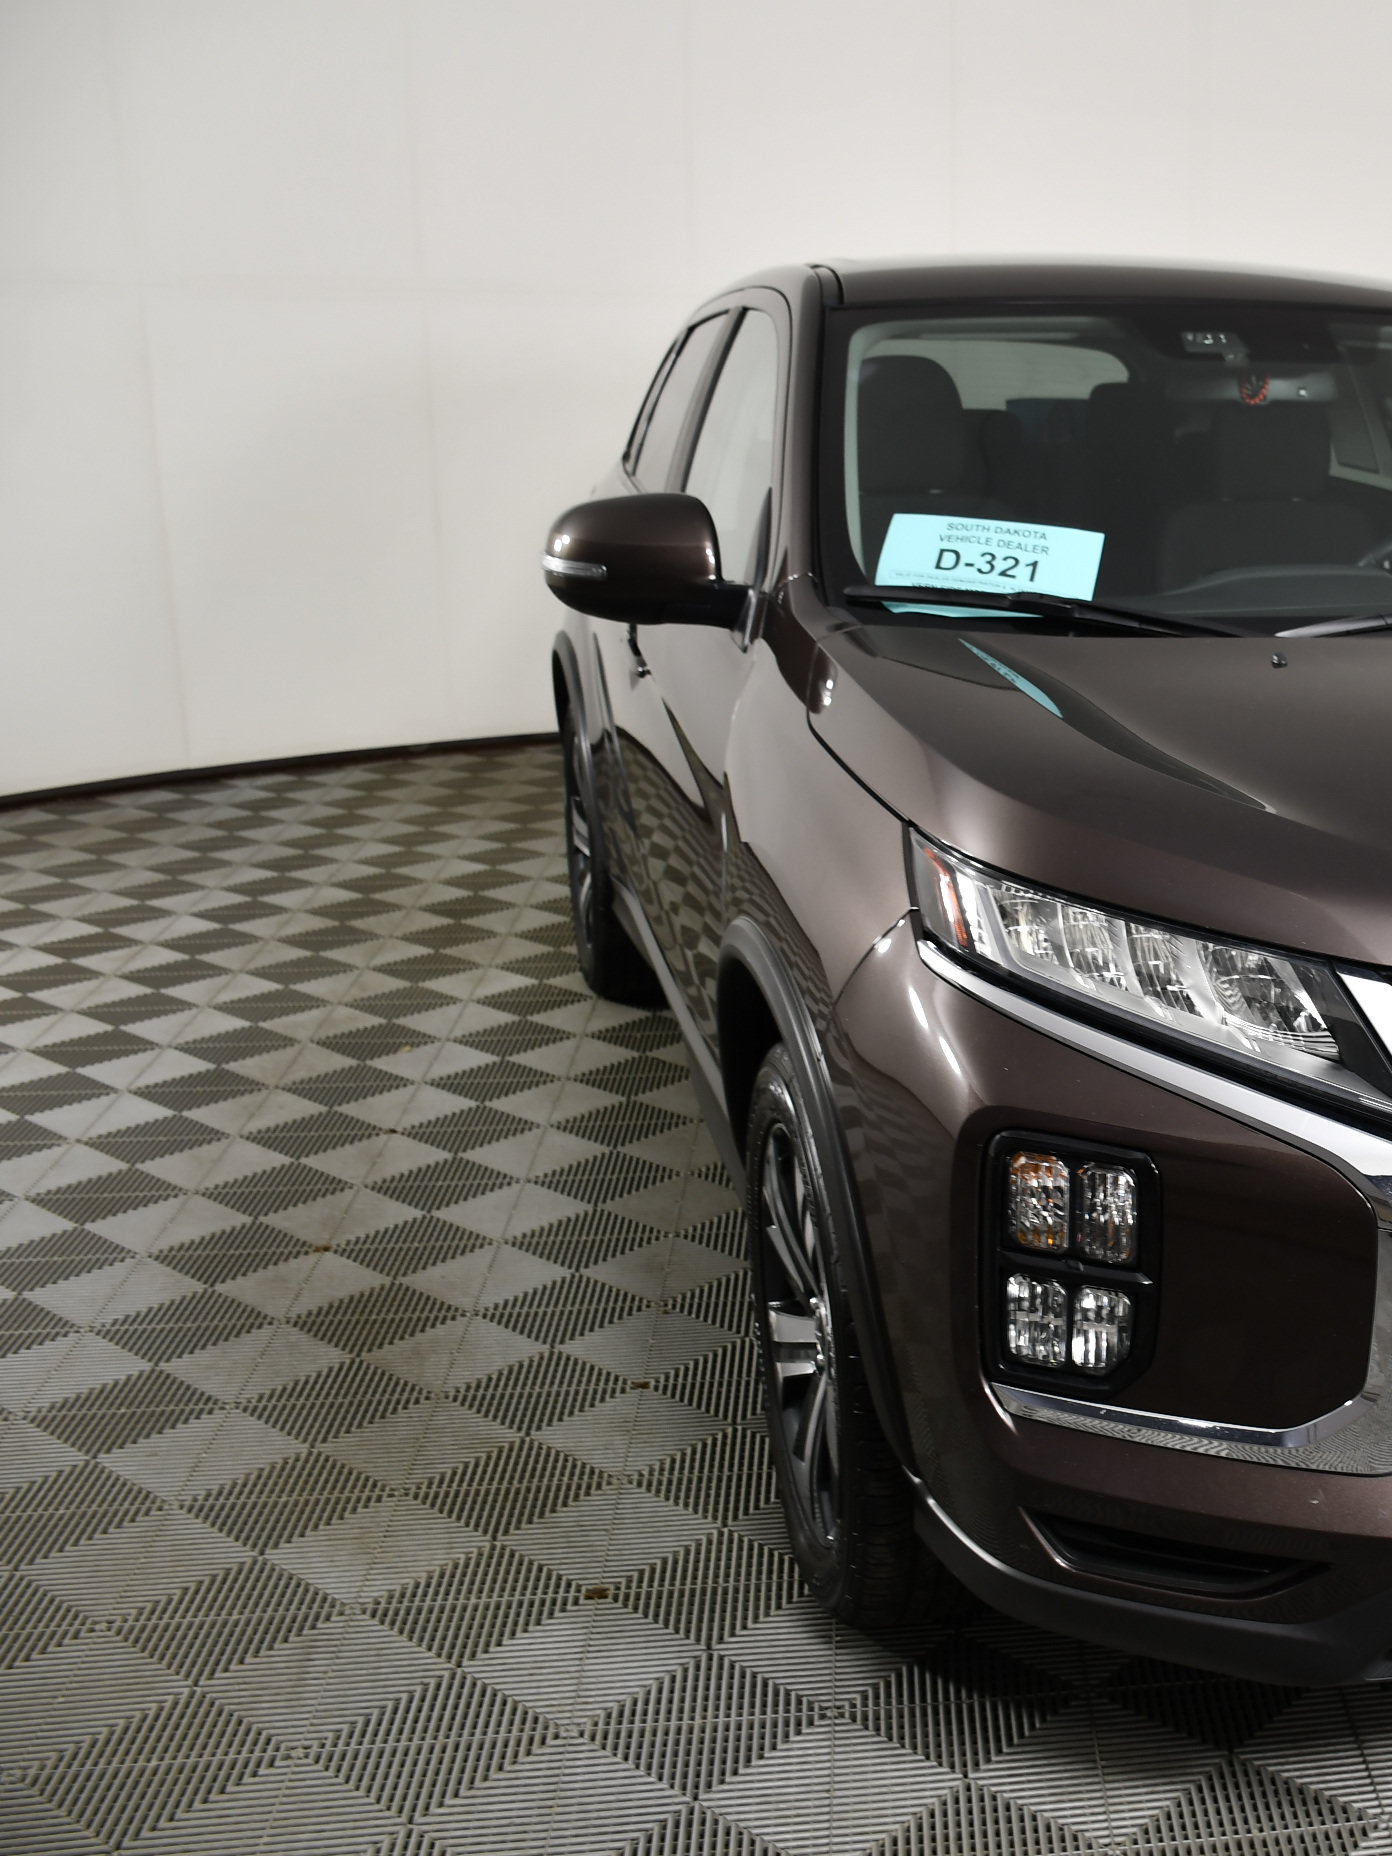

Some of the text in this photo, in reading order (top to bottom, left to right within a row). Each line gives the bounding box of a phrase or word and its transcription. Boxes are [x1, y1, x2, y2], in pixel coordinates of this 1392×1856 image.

[946, 522, 1048, 541] SOUTH DAKOTA
[939, 534, 1050, 556] VEHICLE DEALER
[934, 548, 1039, 583] D-321
